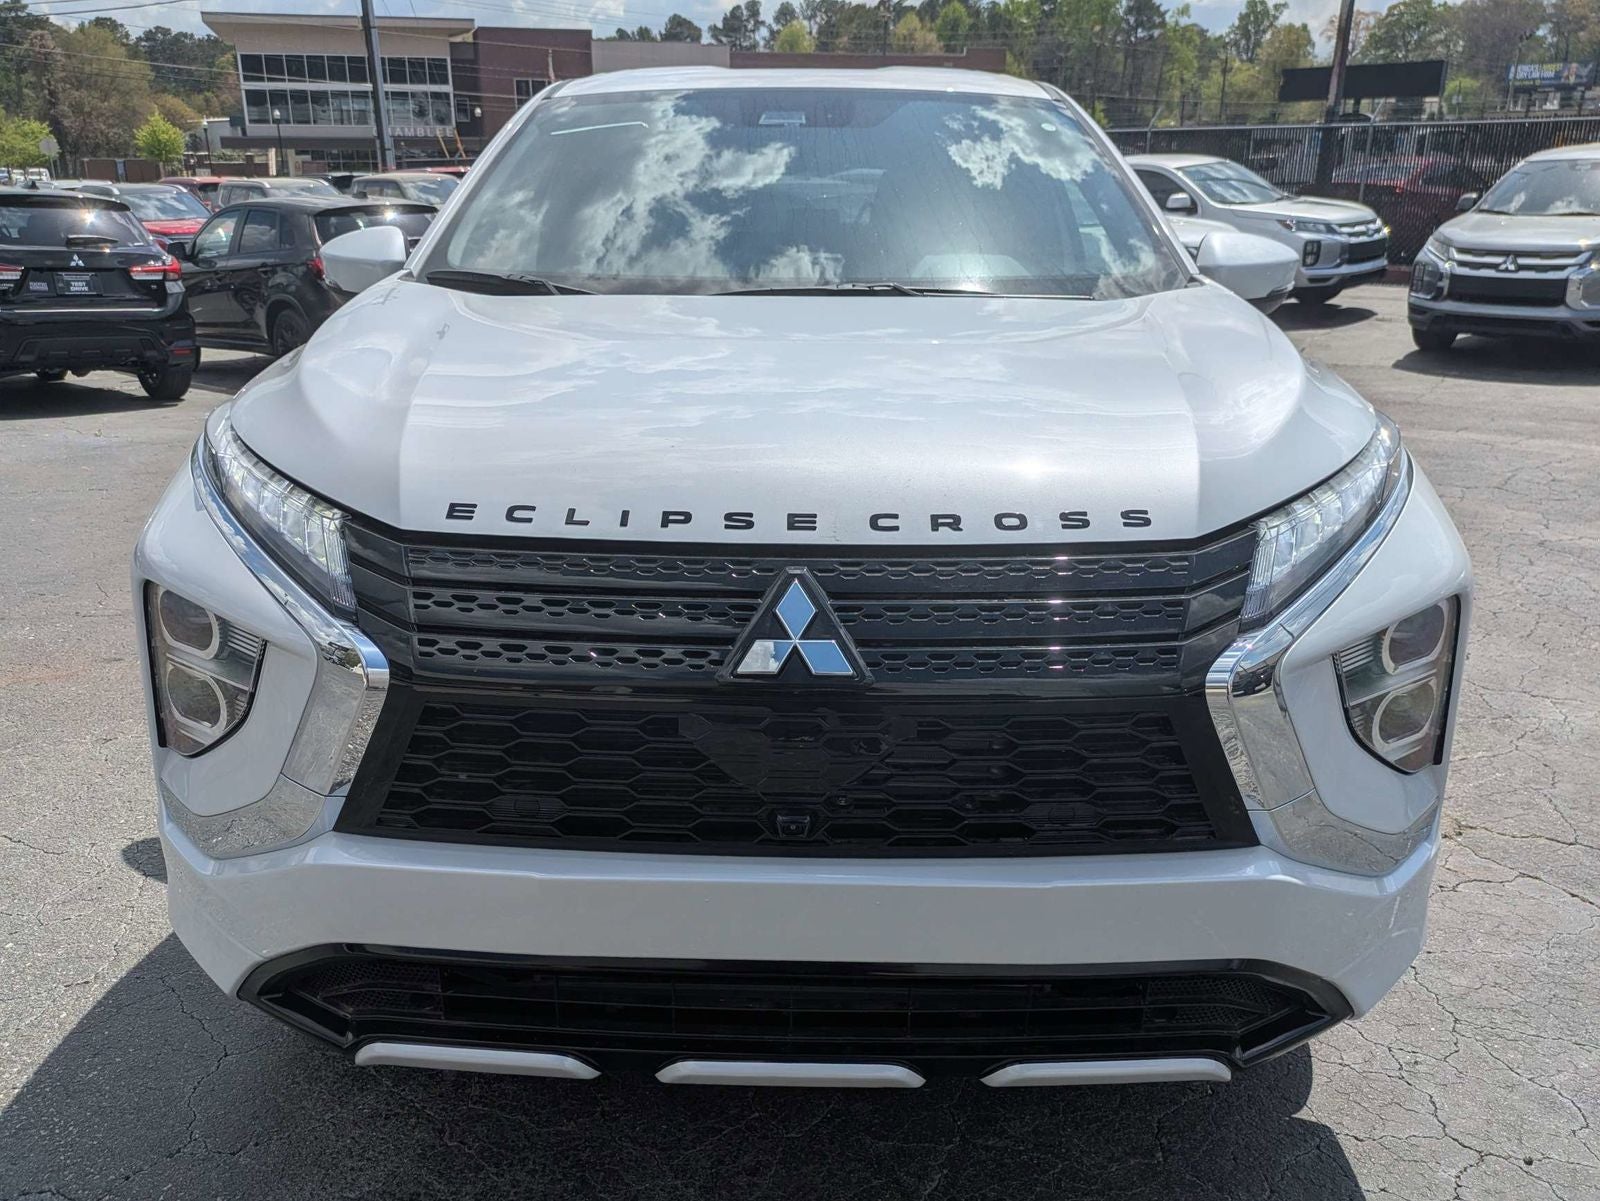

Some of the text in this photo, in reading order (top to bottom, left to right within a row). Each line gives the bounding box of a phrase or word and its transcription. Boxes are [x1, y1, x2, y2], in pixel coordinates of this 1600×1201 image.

[372, 126, 454, 137] CAMBLEE
[445, 502, 1152, 532] ECLIPSE CROSS
